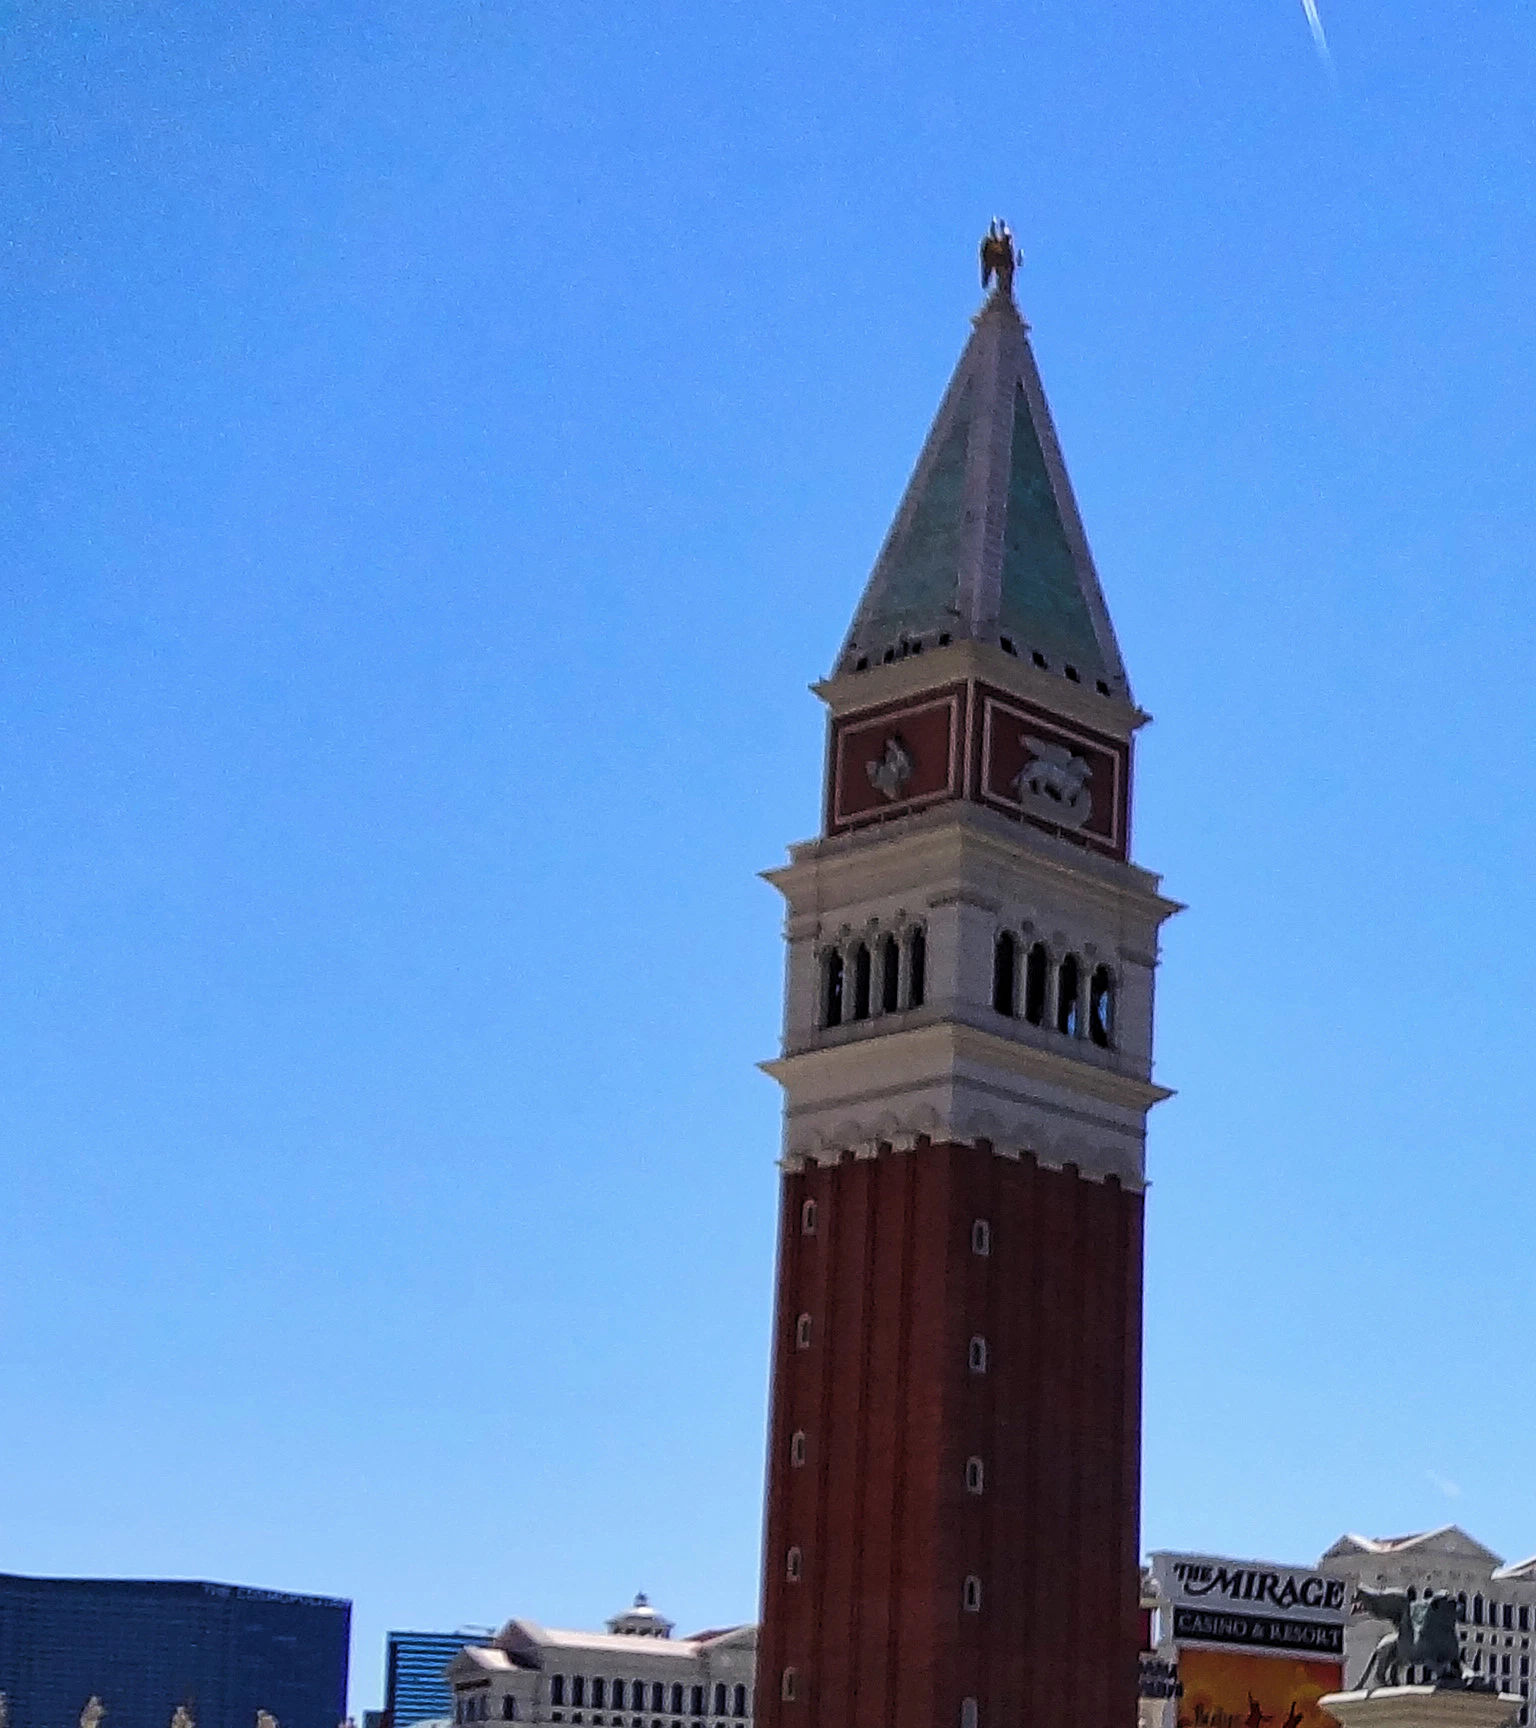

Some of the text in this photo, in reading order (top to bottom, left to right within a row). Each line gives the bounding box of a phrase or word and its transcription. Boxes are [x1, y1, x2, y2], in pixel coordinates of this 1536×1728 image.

[1173, 1562, 1346, 1609] THE MIRAGE
[1177, 1612, 1341, 1649] CASINO & RESORT
